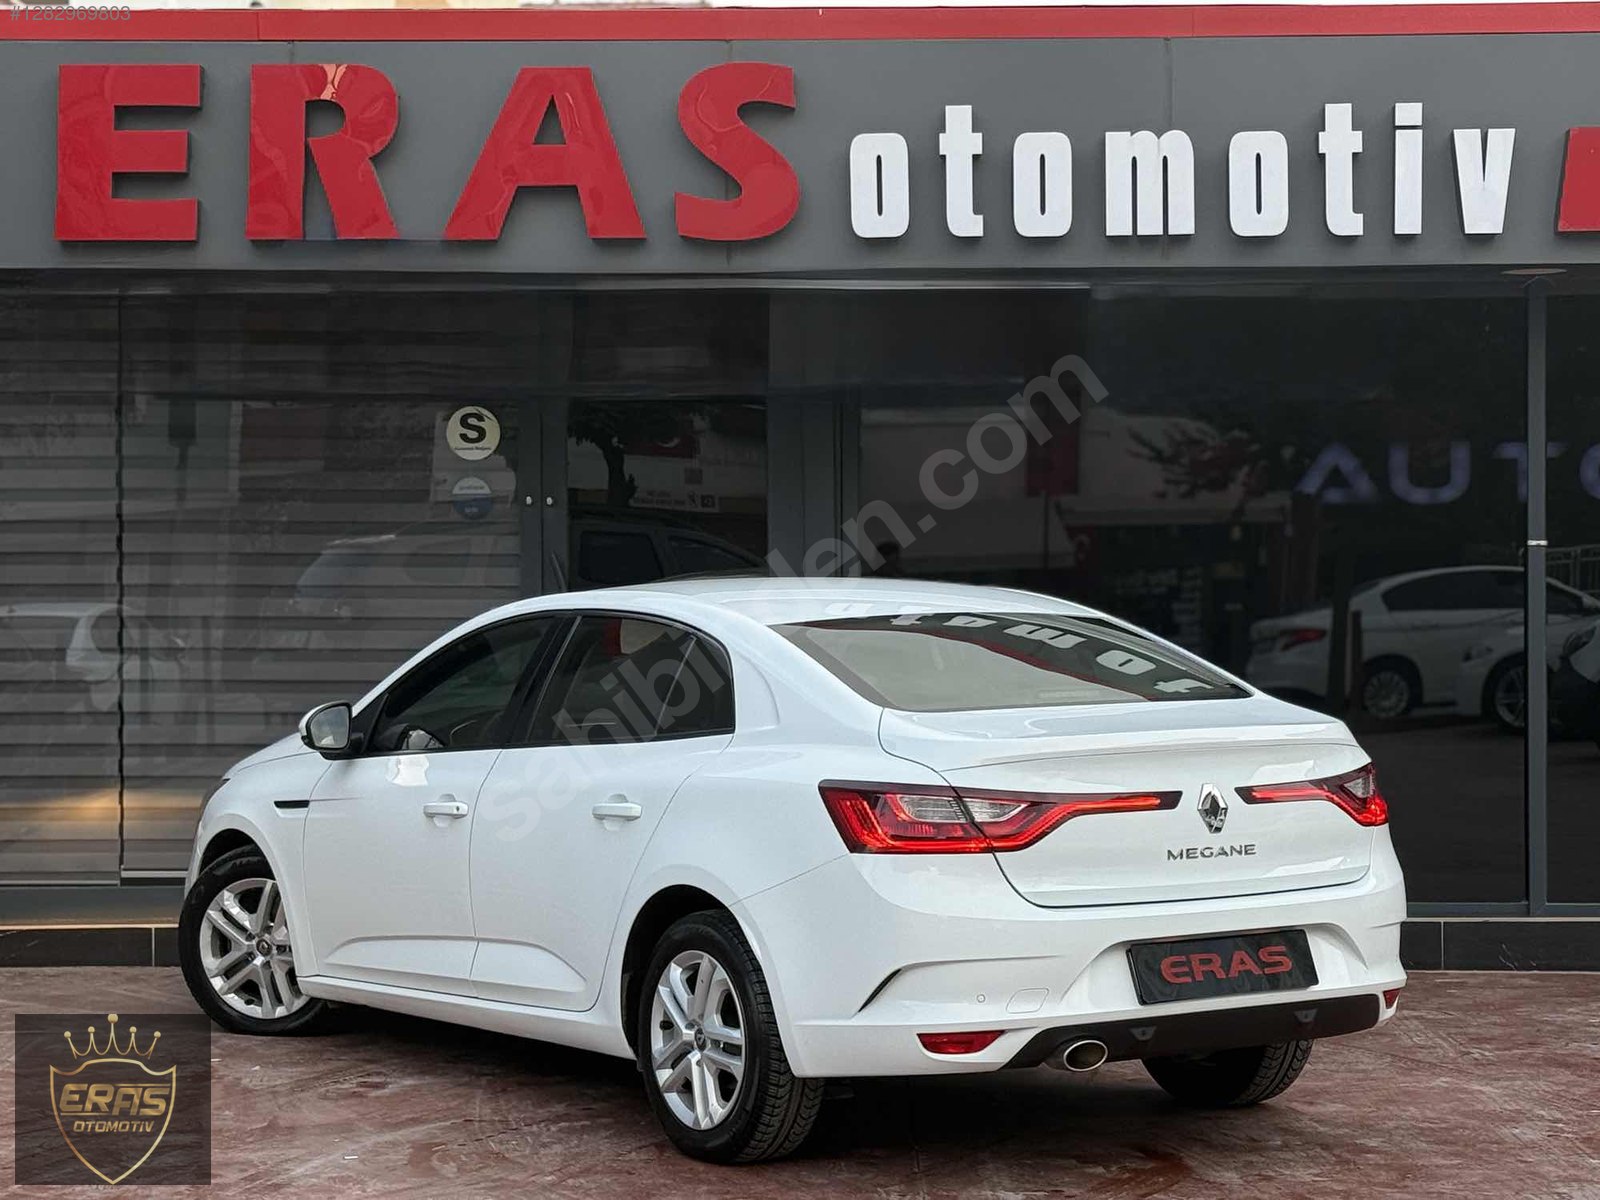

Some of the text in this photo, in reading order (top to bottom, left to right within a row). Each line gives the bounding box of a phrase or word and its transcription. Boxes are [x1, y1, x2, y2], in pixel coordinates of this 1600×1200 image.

[54, 61, 1515, 241] ERAS otomotiv
[459, 412, 487, 444] S
[1167, 844, 1256, 861] MEGANE
[1160, 946, 1293, 983] ERAS
